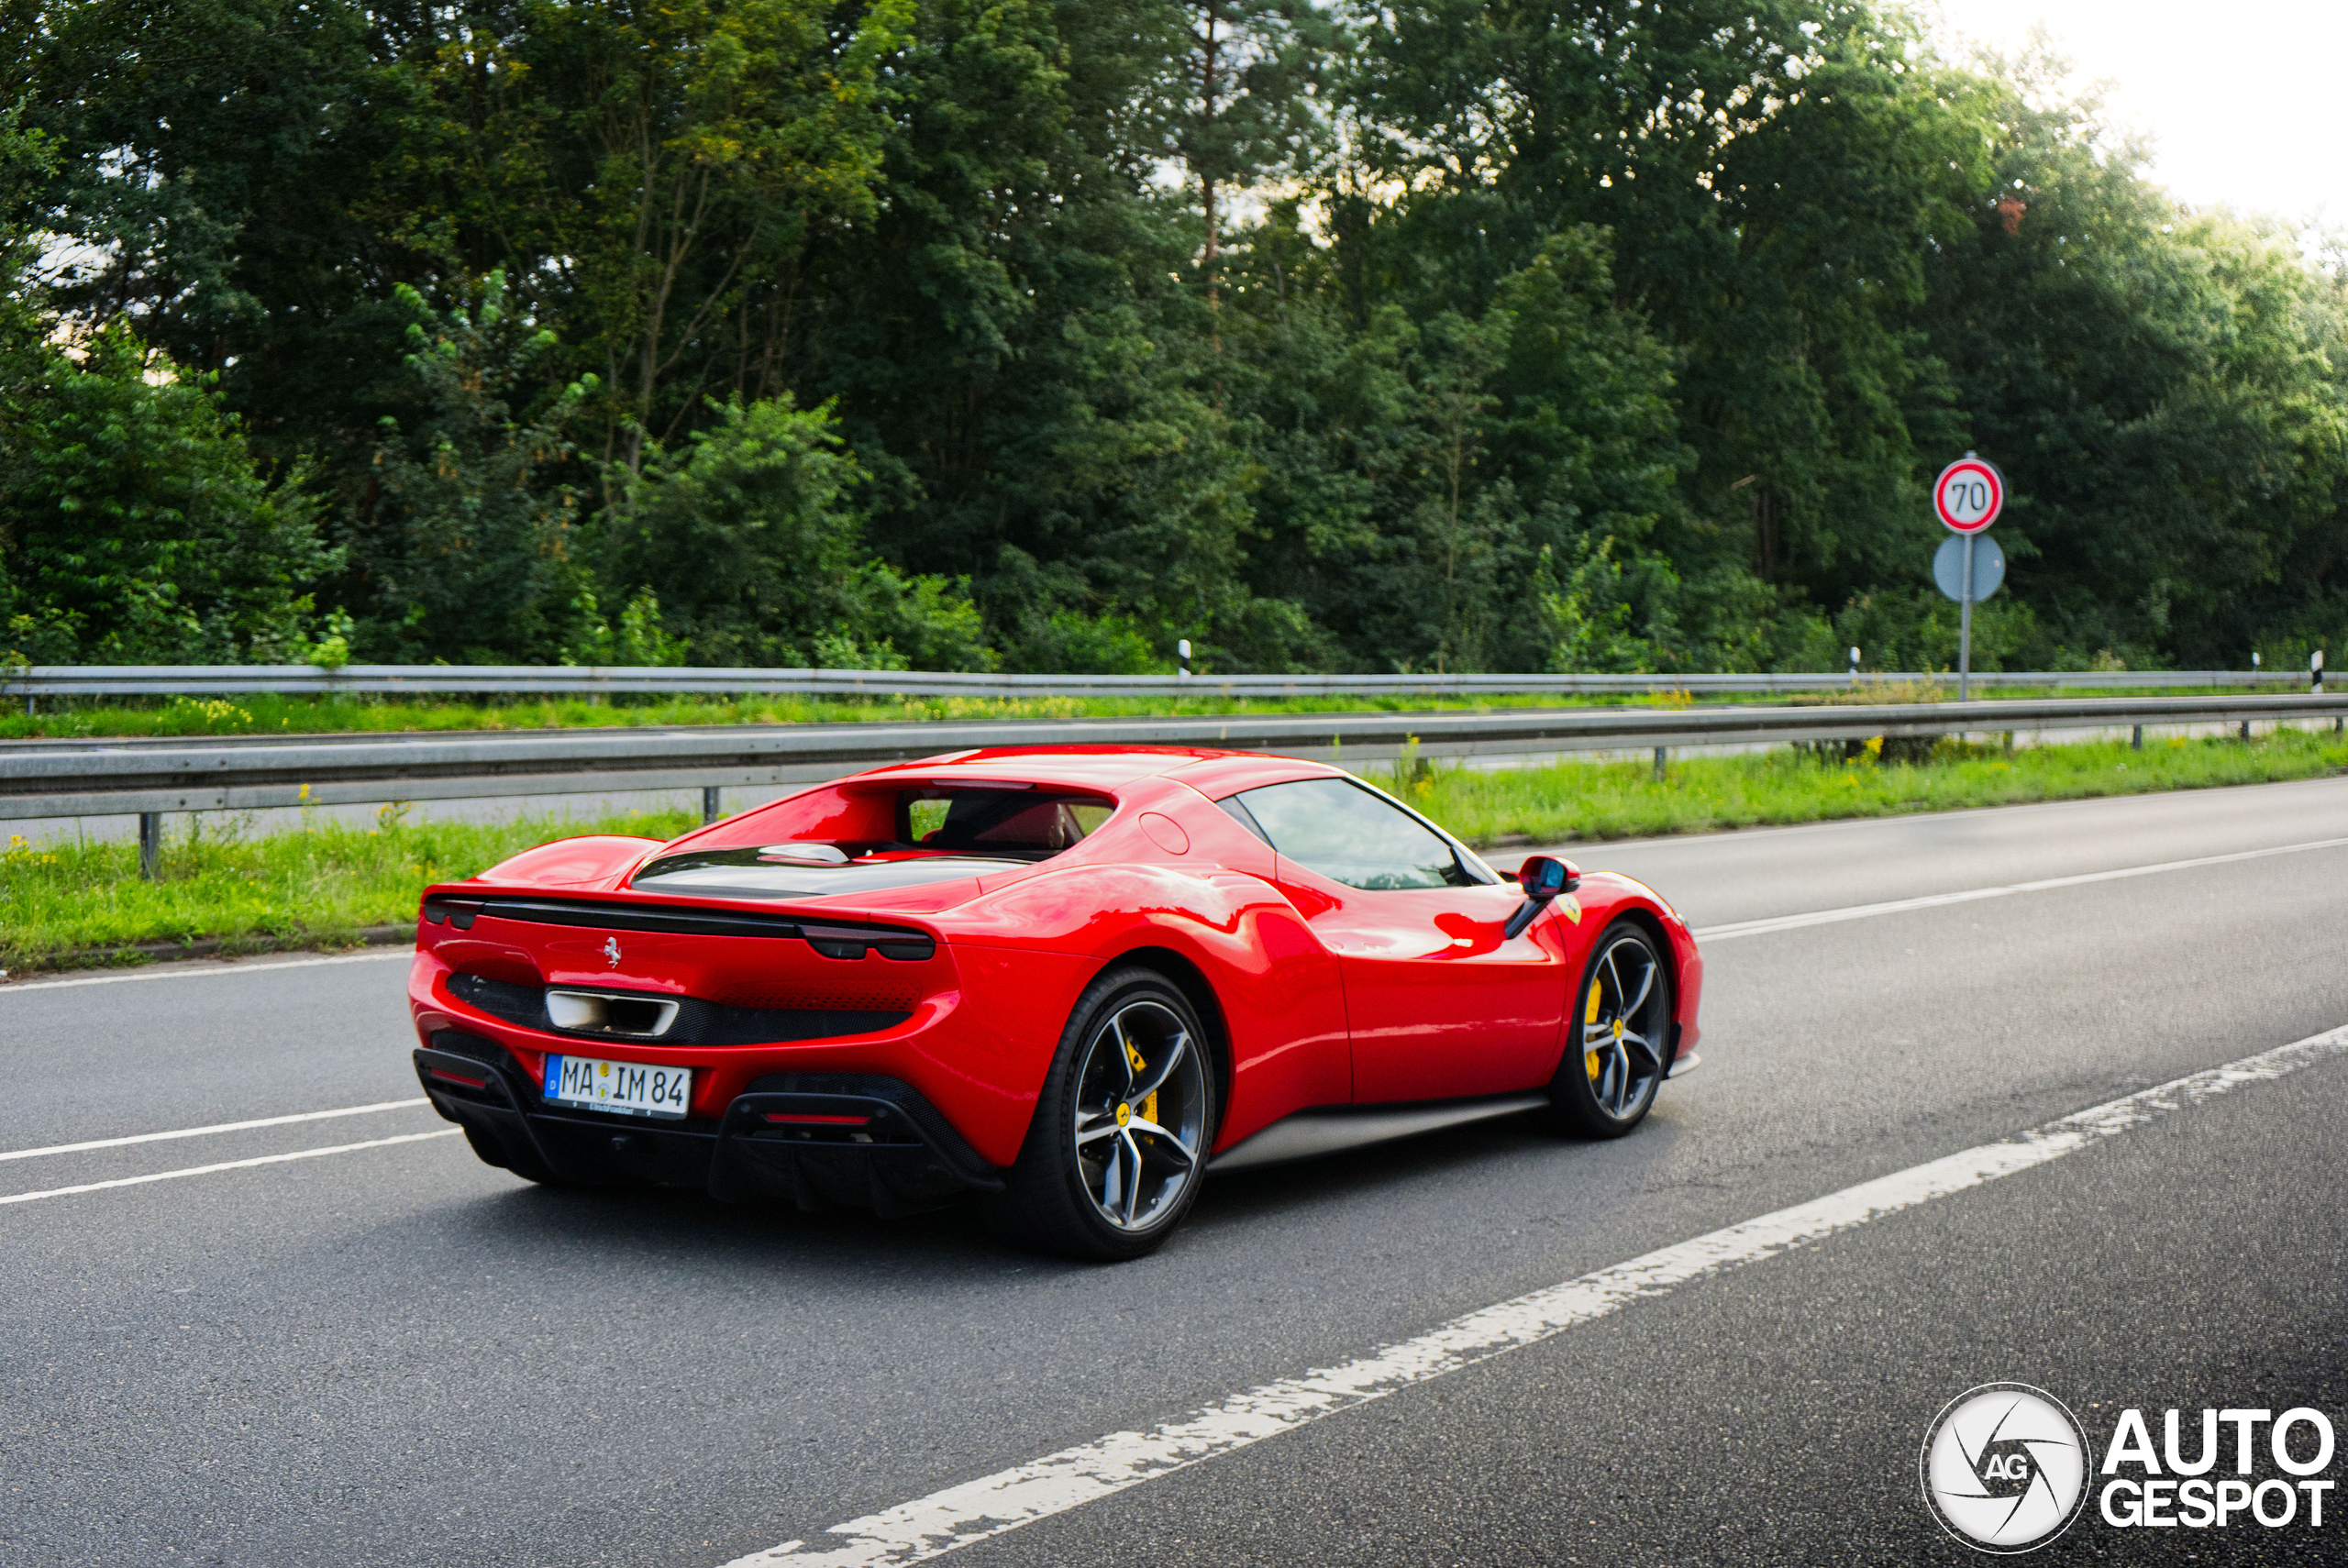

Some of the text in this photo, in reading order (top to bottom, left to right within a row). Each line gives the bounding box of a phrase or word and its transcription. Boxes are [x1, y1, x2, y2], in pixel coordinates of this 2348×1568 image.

[1952, 481, 1987, 513] 70
[549, 1080, 557, 1090] D
[561, 1061, 593, 1096] MA
[613, 1066, 646, 1102] IM
[651, 1071, 683, 1107] 84
